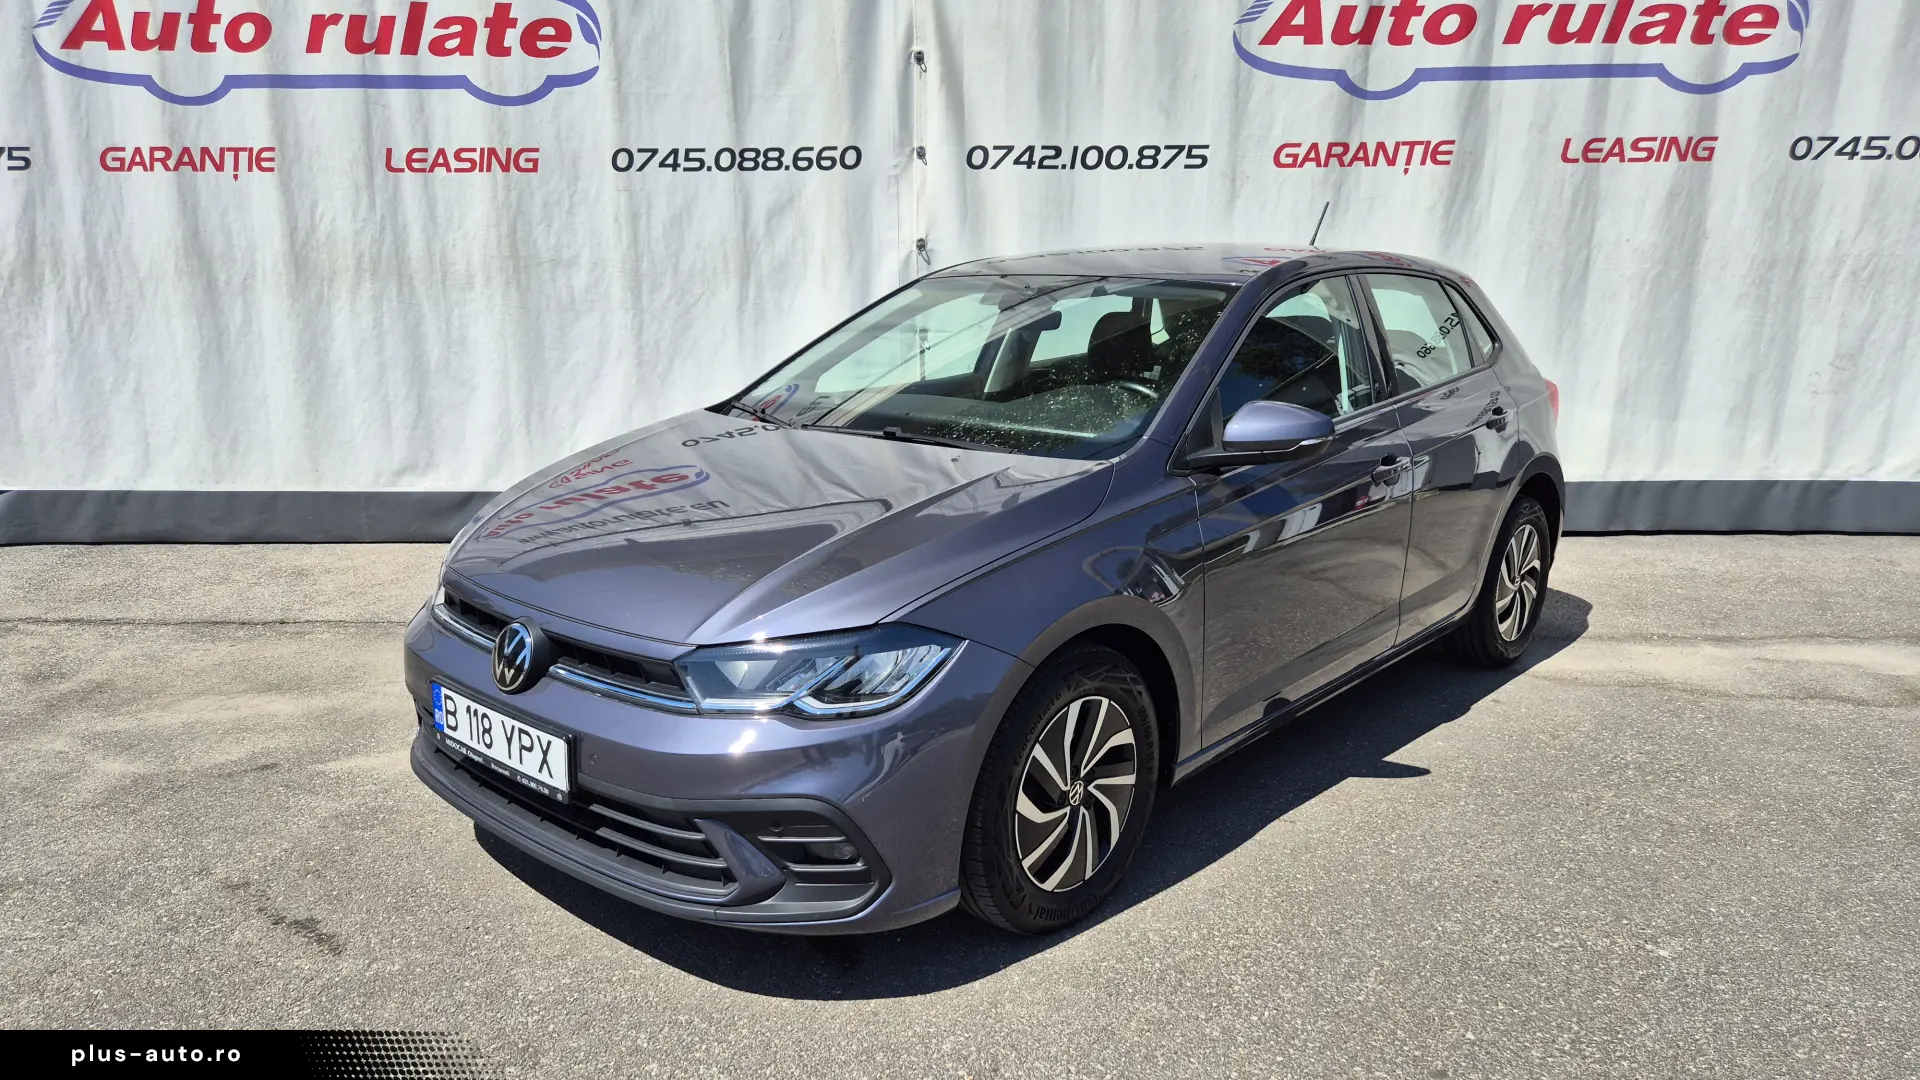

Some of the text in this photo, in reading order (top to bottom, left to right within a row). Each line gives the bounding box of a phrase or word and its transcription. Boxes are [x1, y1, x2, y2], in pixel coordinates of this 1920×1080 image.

[61, 0, 573, 58] Auto rulate
[1259, 0, 1780, 46] Auto rulate
[385, 147, 540, 173] LEASING
[611, 145, 862, 173] 0745.088.660
[966, 144, 1210, 171] 0742.100.875
[1561, 136, 1718, 164] LEASING
[1789, 135, 1920, 161] 0745.0
[444, 693, 554, 779] B 118 YPX
